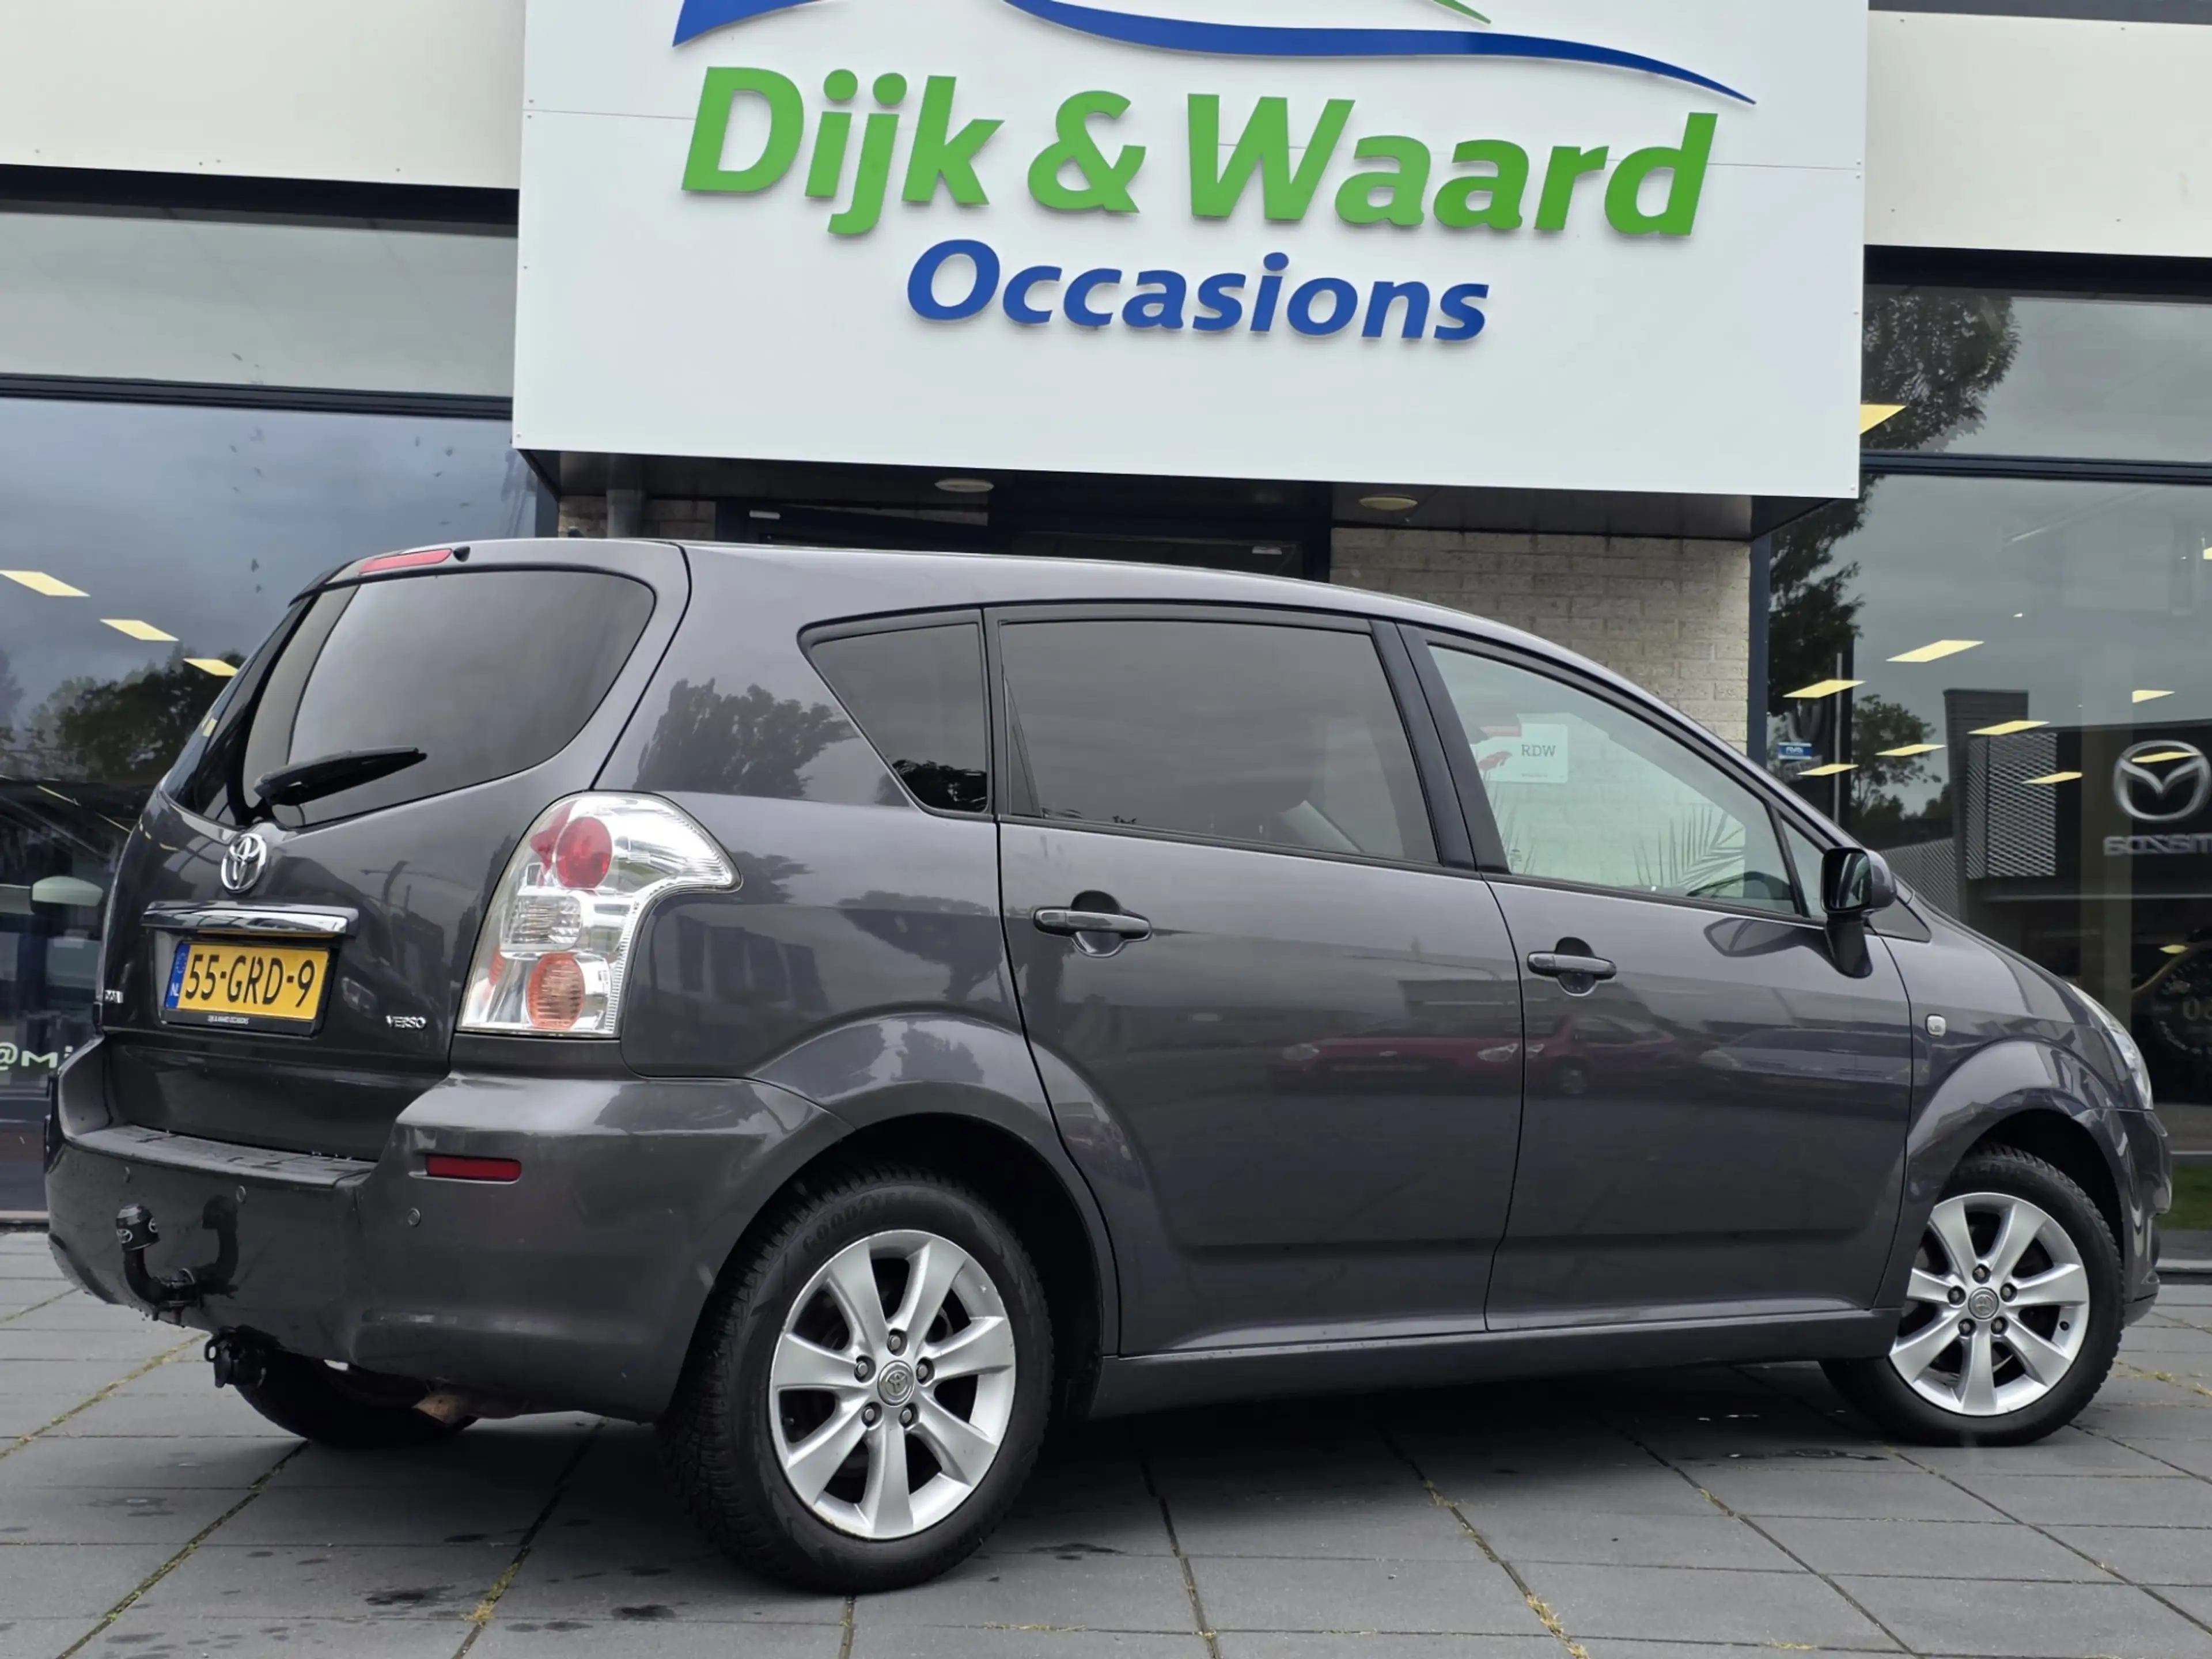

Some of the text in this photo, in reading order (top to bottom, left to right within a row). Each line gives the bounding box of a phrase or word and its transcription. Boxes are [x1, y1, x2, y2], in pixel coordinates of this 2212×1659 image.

[681, 66, 1718, 236] Dijk & Waard
[907, 239, 1490, 341] Occasions
[1521, 744, 1556, 757] RDW
[171, 953, 316, 1007] NL 55-GRD-9
[385, 1014, 426, 1029] VERSO
